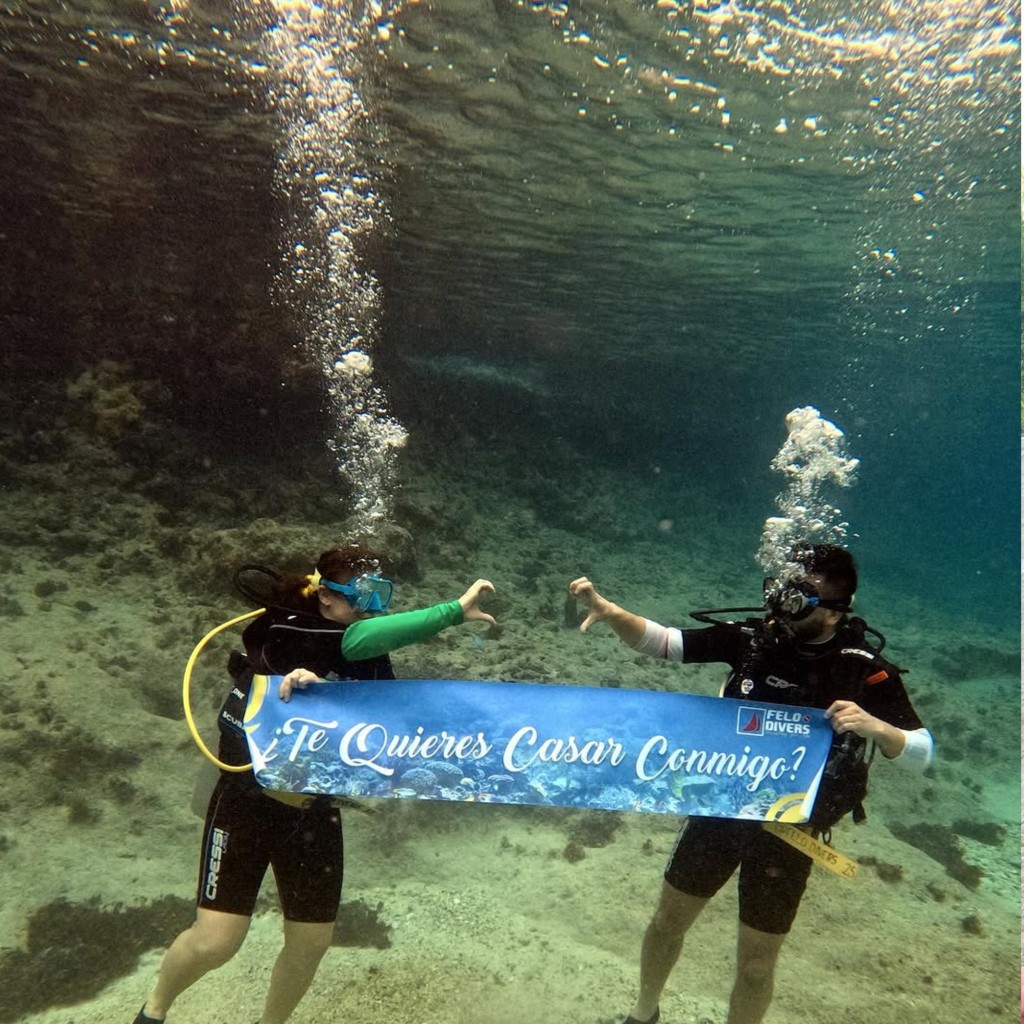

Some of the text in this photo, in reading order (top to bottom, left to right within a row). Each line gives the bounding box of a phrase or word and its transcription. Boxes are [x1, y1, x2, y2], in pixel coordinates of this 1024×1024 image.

[765, 720, 811, 735] DIVERS
[766, 709, 801, 722] FELO
[338, 722, 493, 776] Quieres
[502, 726, 626, 773] Casar
[635, 735, 807, 792] Conmigo?
[206, 828, 224, 901] CRESSI
